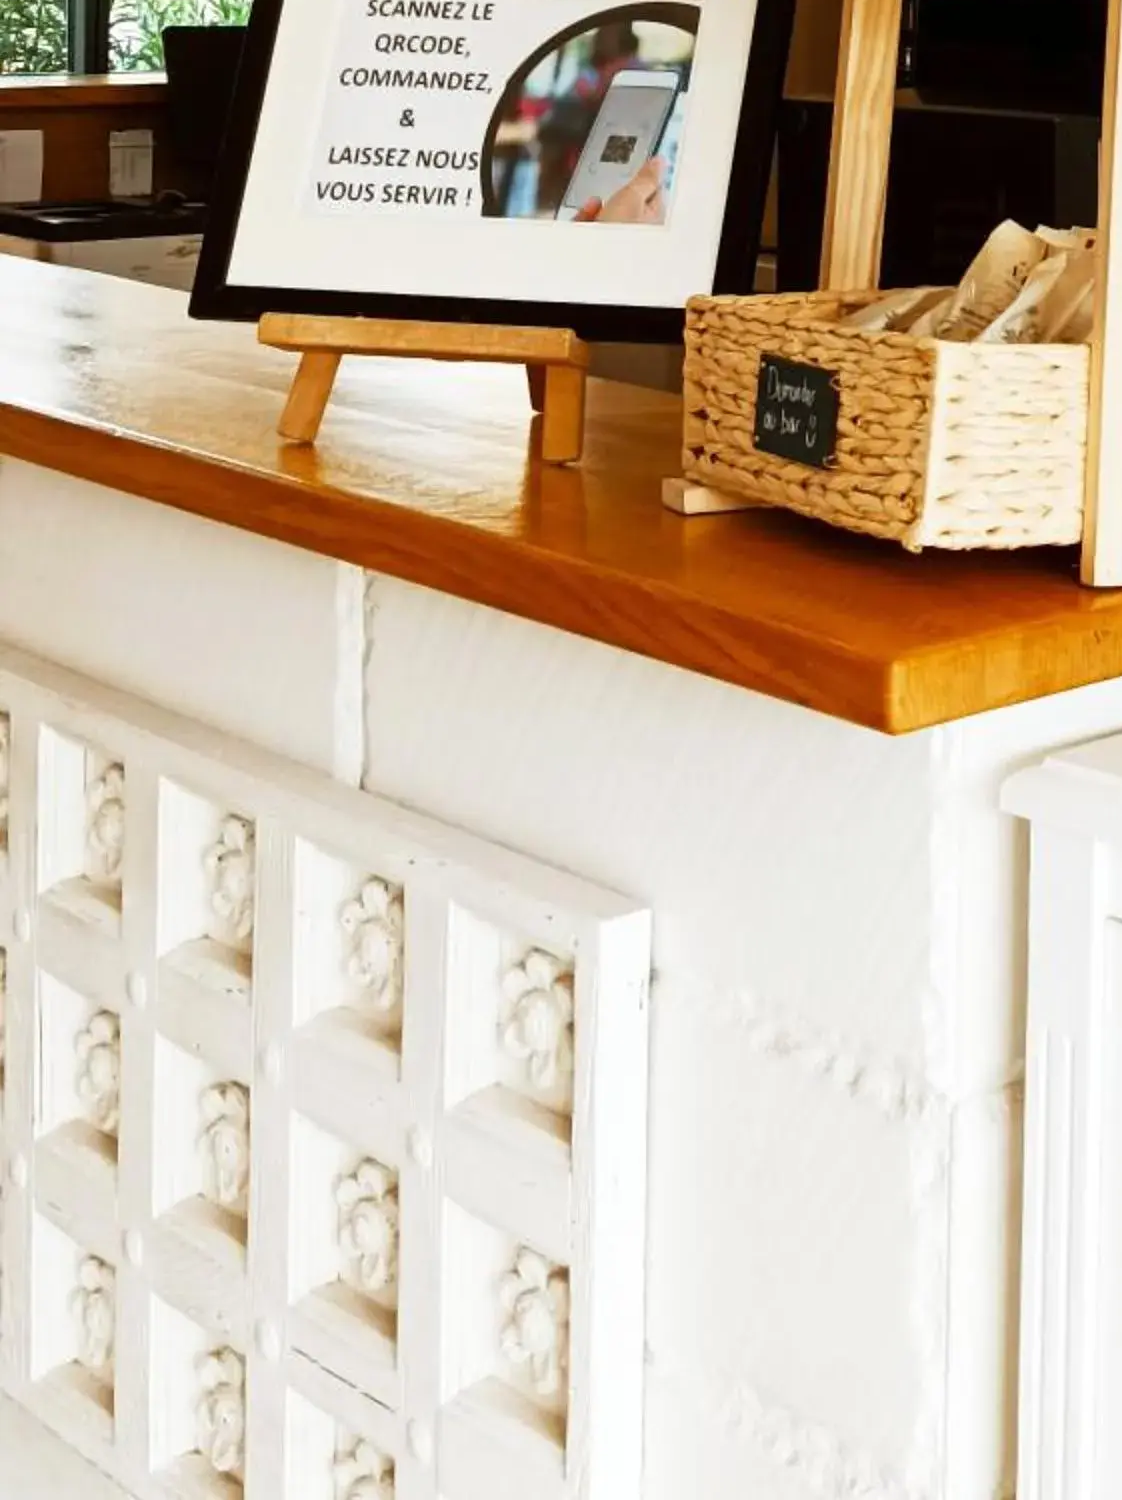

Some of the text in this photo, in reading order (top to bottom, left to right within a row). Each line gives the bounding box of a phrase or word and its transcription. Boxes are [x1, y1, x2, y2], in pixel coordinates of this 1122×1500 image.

[471, 3, 495, 21] LE
[374, 33, 471, 58] QRCODE,
[339, 67, 493, 93] COMMANDEZ,
[399, 109, 415, 127] &
[328, 146, 479, 171] LAISSEZ NOUS
[316, 181, 473, 207] VOUS SERVIR !
[781, 409, 801, 434] bar
